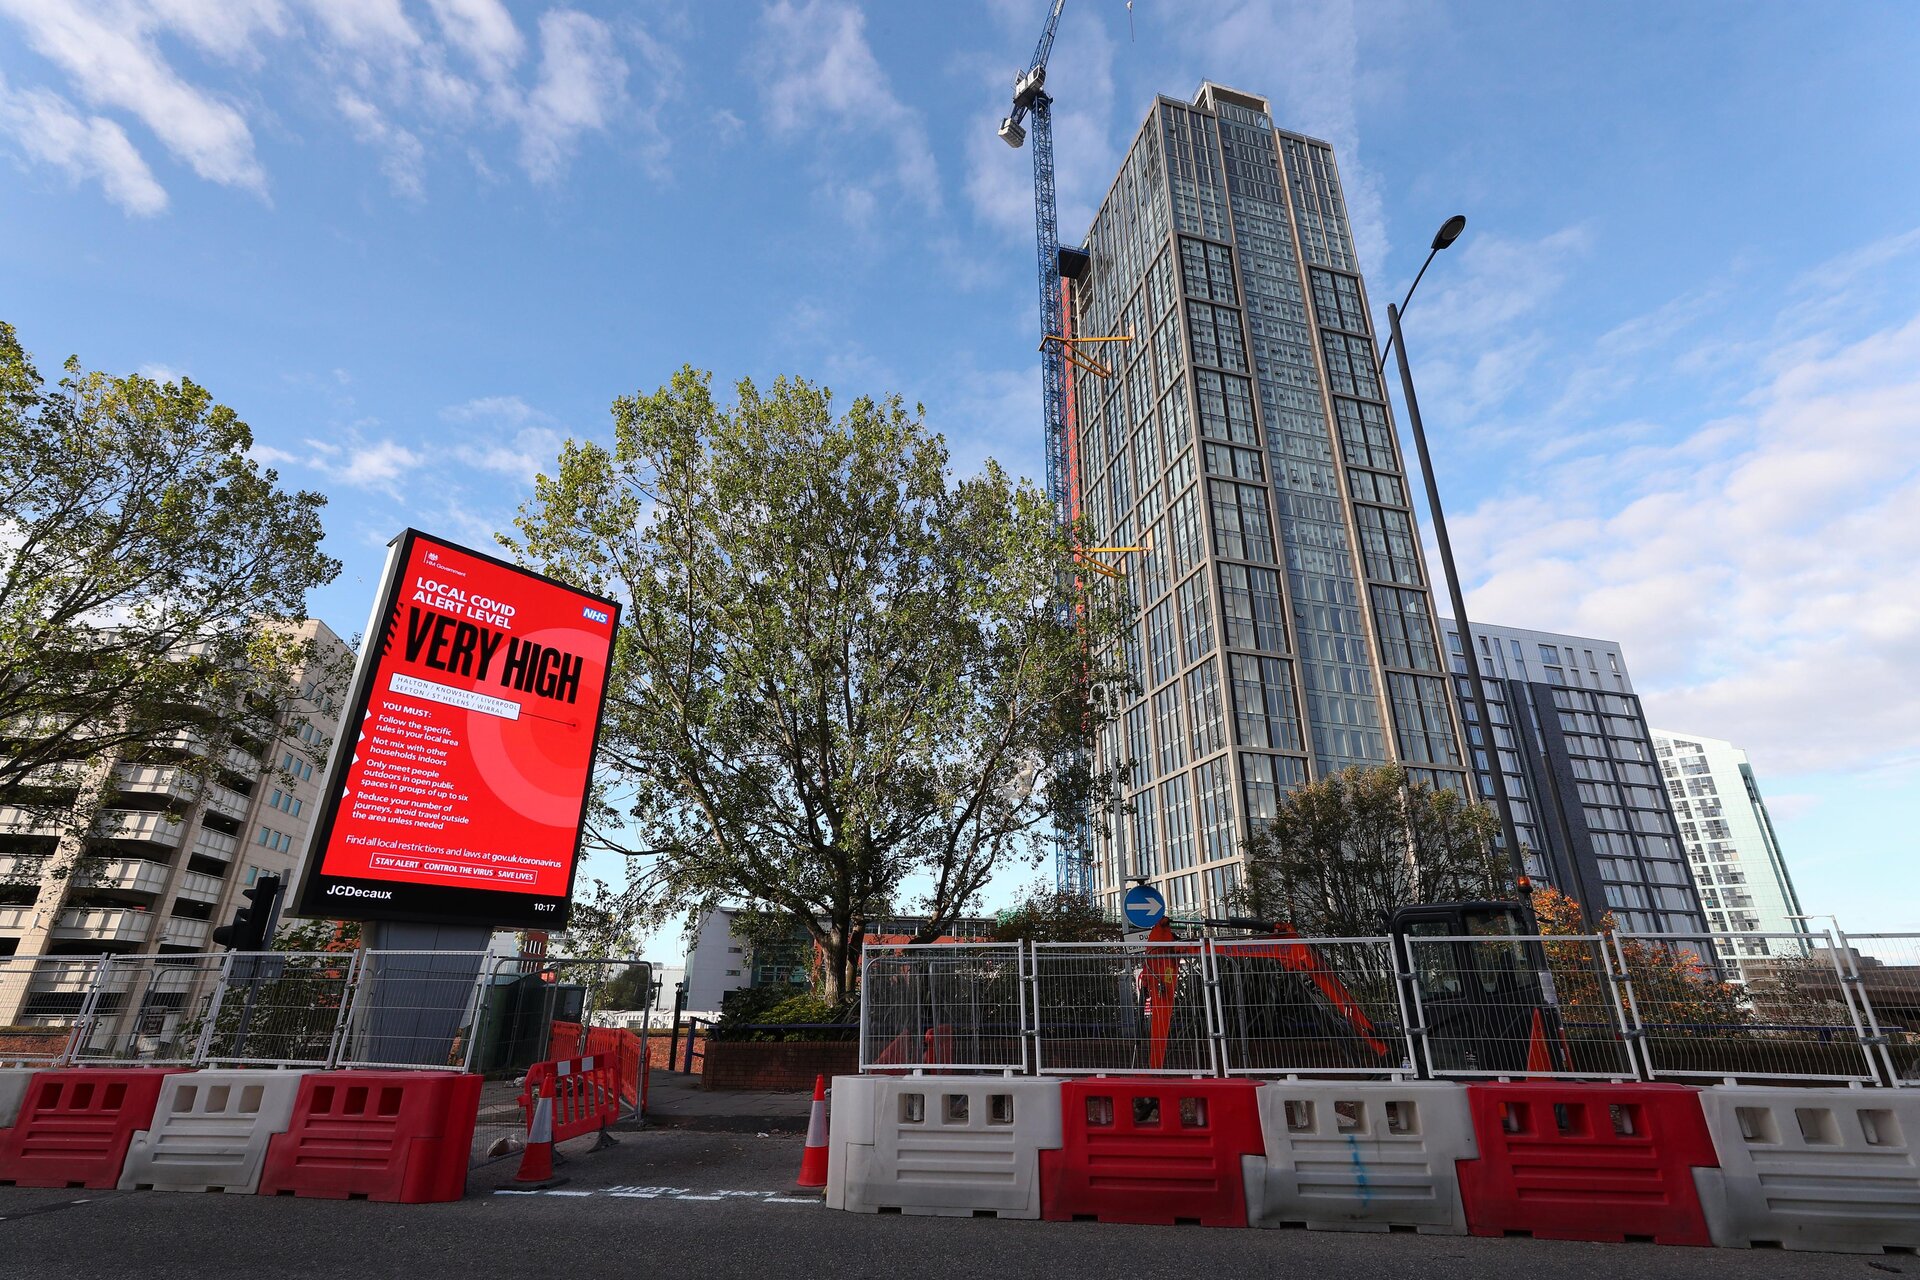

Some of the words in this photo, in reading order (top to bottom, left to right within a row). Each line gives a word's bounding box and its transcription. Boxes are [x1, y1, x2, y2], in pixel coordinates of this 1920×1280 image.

[436, 563, 466, 577] Government
[416, 577, 467, 602] LOCAL
[470, 595, 516, 617] COVID
[412, 590, 464, 614] ALERT
[466, 606, 511, 629] LEVEL
[583, 608, 608, 622] NHS
[404, 606, 503, 681] VERY
[500, 637, 583, 704] HIGH
[396, 684, 424, 696] SEFTON
[443, 695, 470, 706] HELENS
[477, 704, 504, 714] WIRRAL
[397, 677, 428, 689] HALTON
[436, 686, 474, 700] KNOWSLEY
[480, 697, 518, 710] LIVERPOOL
[382, 701, 402, 711] YOU
[403, 706, 432, 718] MUST:
[376, 724, 396, 733] rules
[405, 731, 422, 739] your
[424, 734, 442, 743] local
[379, 714, 406, 726] Follow
[409, 720, 422, 729] the
[424, 725, 452, 736] specific
[370, 745, 416, 760] households
[418, 754, 447, 766] indoors
[373, 736, 388, 746] Not
[406, 744, 424, 753] with
[426, 748, 447, 757] other
[366, 759, 387, 770] Only
[388, 764, 410, 773] meet
[411, 768, 440, 778] people
[361, 778, 388, 789] spaces
[399, 785, 426, 795] groups
[364, 769, 401, 781] outdoors
[432, 780, 454, 790] public
[357, 791, 389, 802] Reduce
[390, 797, 410, 806] your
[411, 800, 442, 810] number
[352, 811, 366, 819] the
[388, 816, 413, 826] unless
[414, 820, 444, 830] needed
[354, 801, 392, 813] journeys,
[394, 807, 417, 816] avoid
[418, 810, 440, 819] travel
[441, 815, 469, 824] outside
[346, 835, 366, 845] Find
[366, 838, 376, 846] all
[377, 838, 398, 848] local
[398, 843, 444, 854] restrictions
[446, 848, 462, 856] and
[463, 849, 481, 859] laws
[492, 854, 562, 868] gov.uk/coronavirus
[375, 857, 395, 866] STAY
[395, 860, 419, 868] ALERT
[424, 862, 458, 873] CONTROL
[459, 866, 472, 874] THE
[473, 868, 493, 876] VIRUS
[498, 870, 515, 879] SAVE
[516, 872, 533, 880] LIVES
[327, 884, 392, 900] JCDecaux
[534, 903, 556, 912] 10:17
